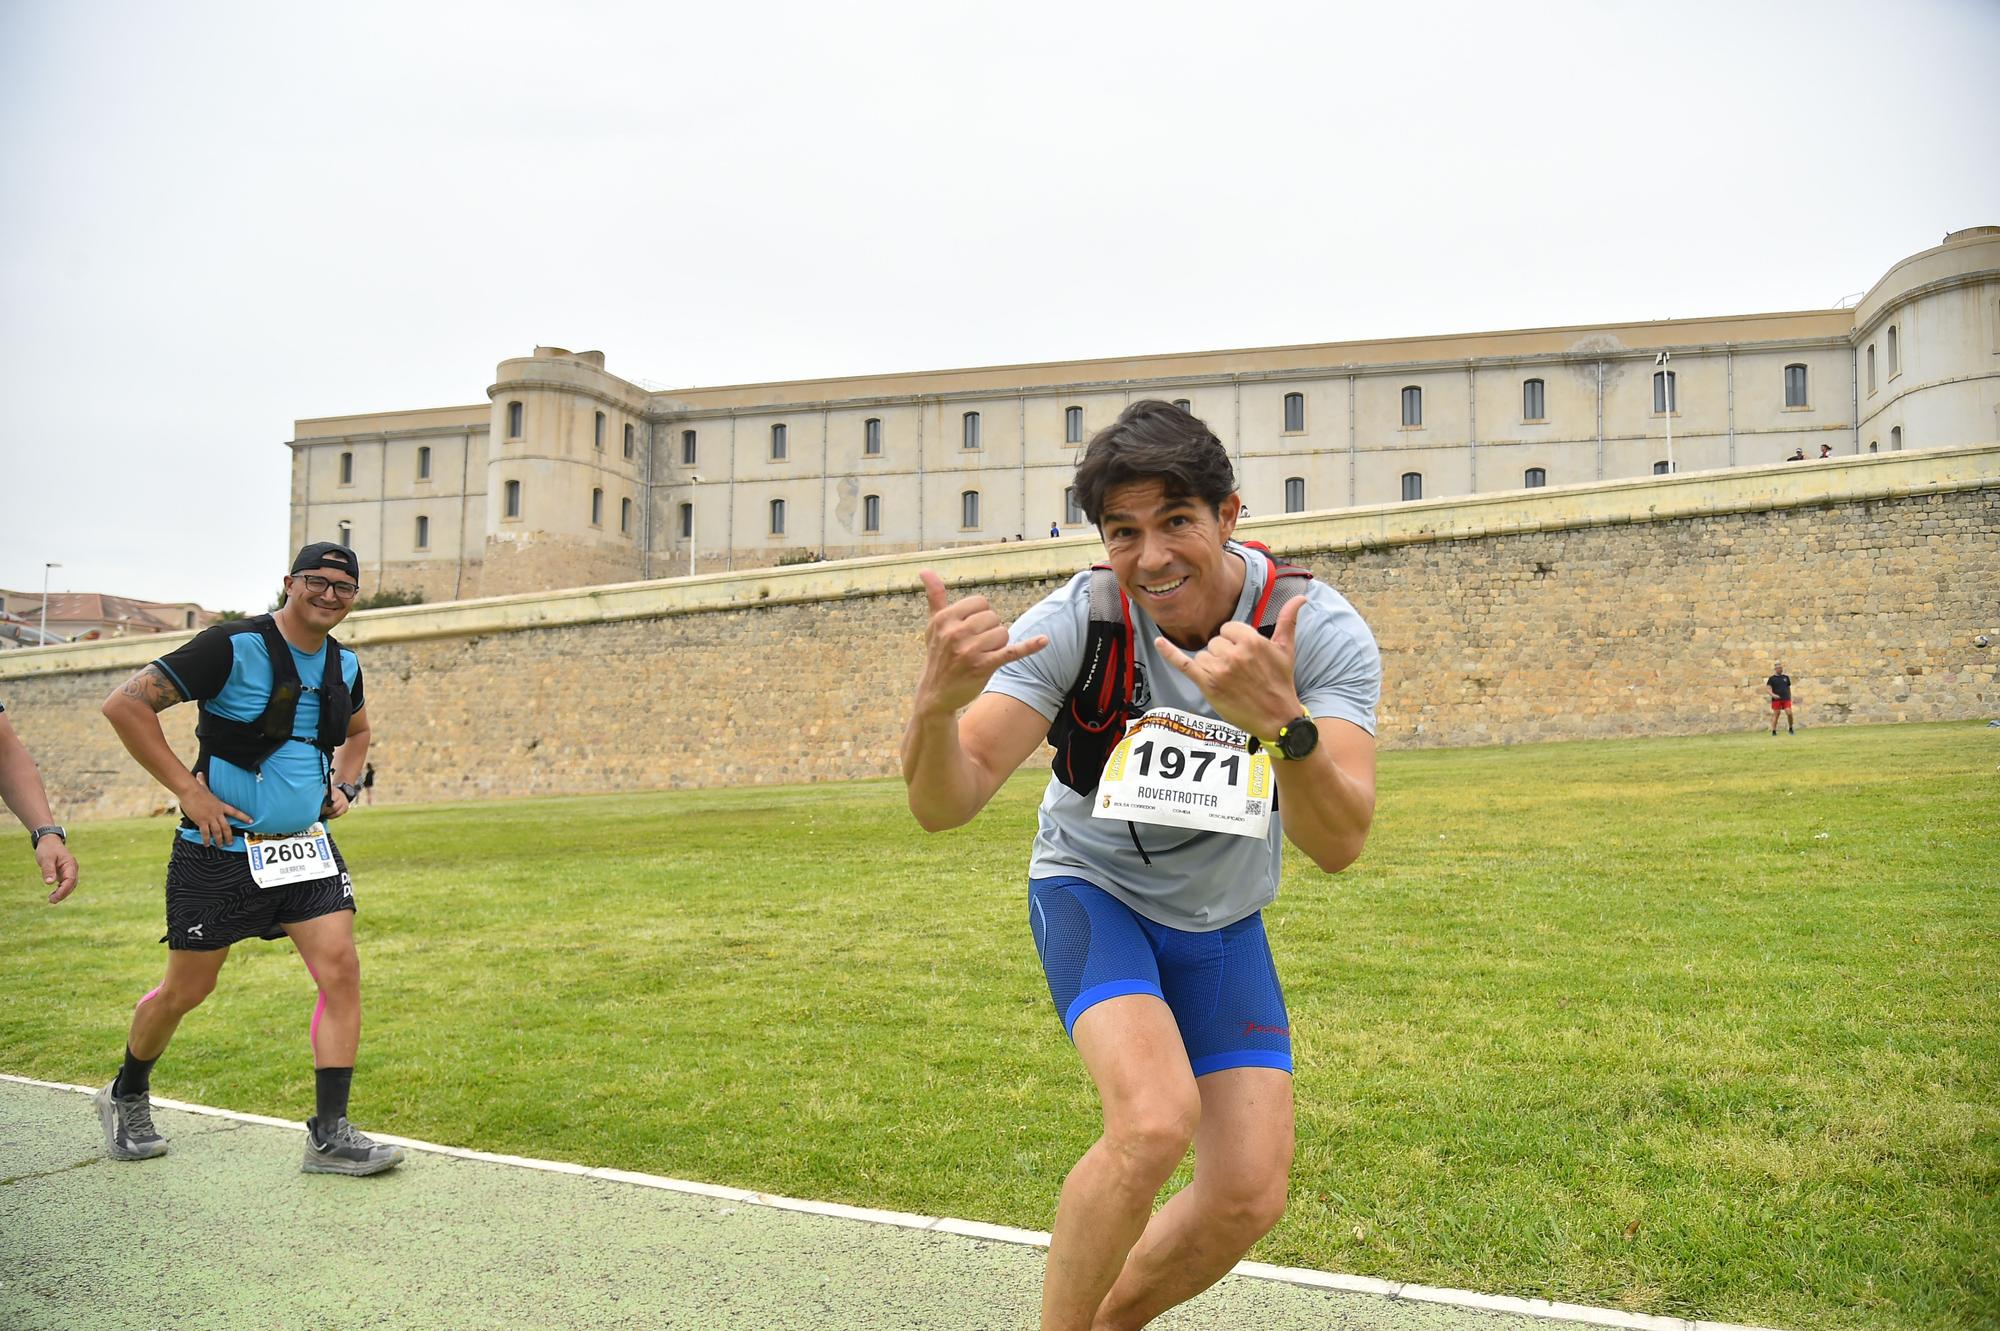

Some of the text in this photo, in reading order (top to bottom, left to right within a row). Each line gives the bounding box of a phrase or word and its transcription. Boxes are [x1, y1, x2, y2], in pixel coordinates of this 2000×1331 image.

[1174, 714, 1186, 724] DE
[1186, 718, 1204, 730] LAS
[1205, 729, 1247, 746] 2023
[1134, 741, 1240, 786] 1971
[1138, 786, 1218, 808] ROVERTROTTER
[264, 842, 317, 865] 2603
